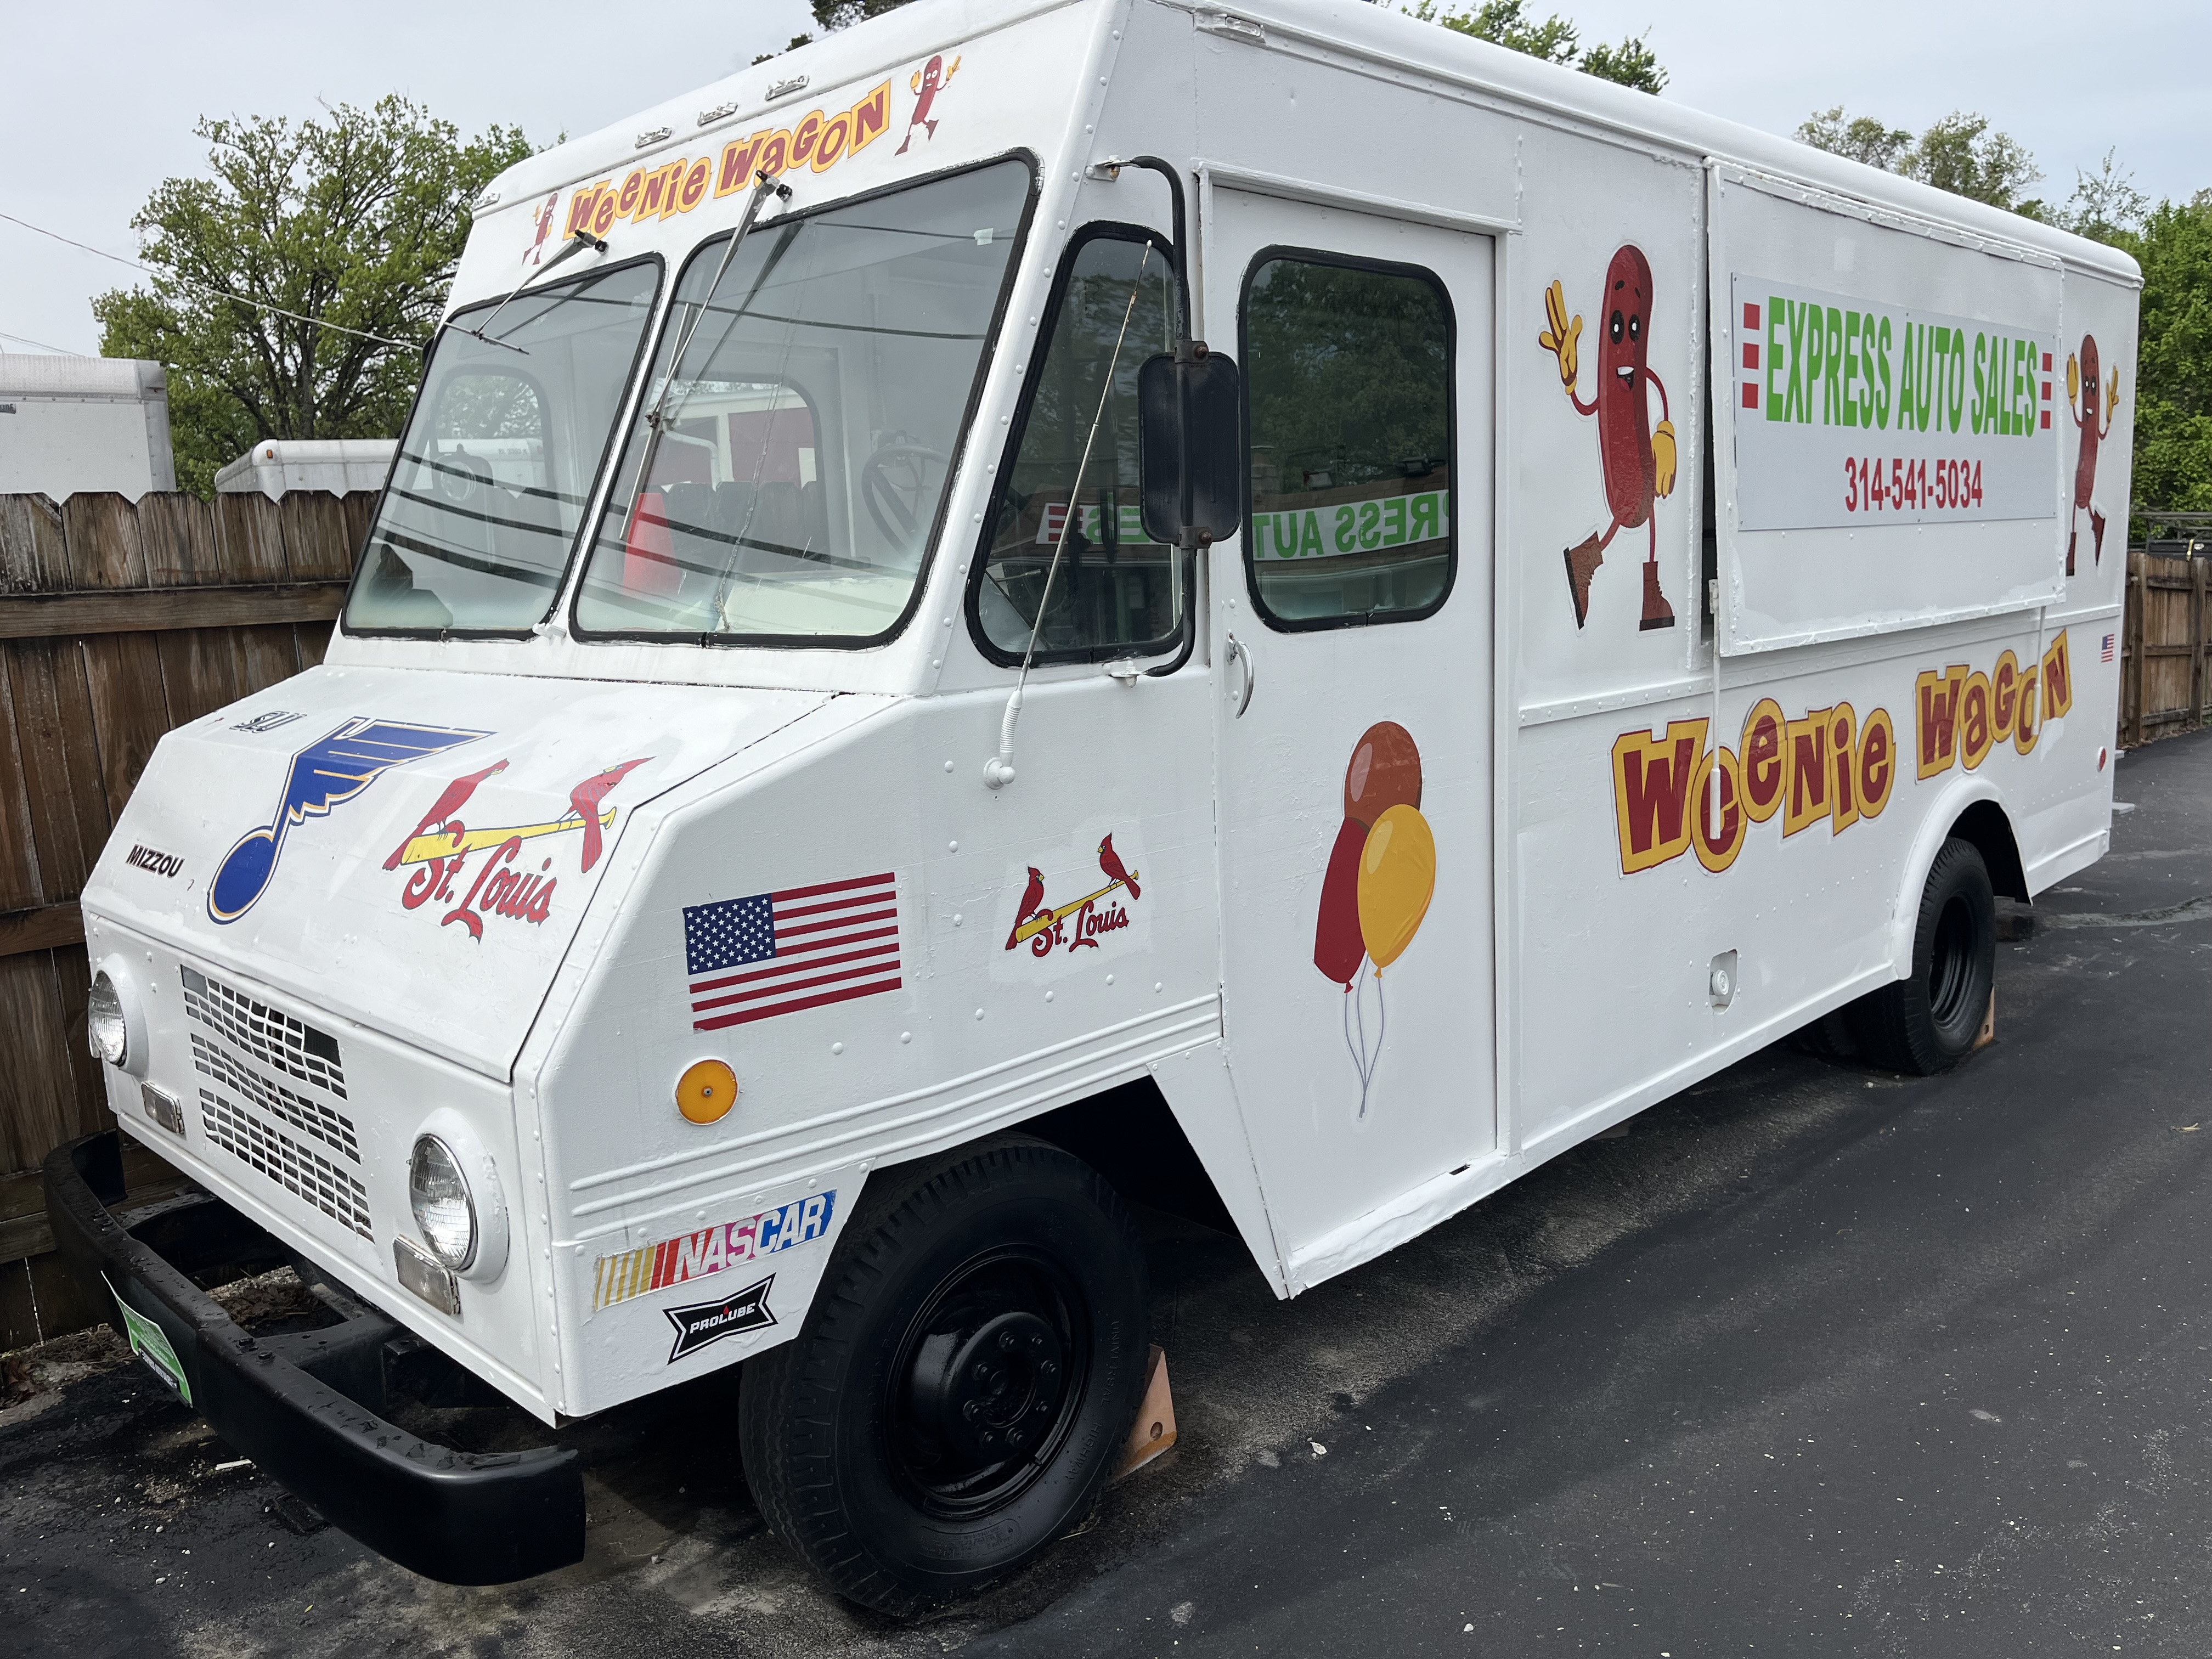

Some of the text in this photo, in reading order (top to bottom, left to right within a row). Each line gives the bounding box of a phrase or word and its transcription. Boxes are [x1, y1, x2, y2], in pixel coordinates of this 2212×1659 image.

[1766, 296, 2037, 438] EXPRESS AUTO SALES
[1844, 456, 1983, 512] 314-541-5034
[125, 843, 185, 878] MIZZOU
[441, 835, 557, 945] Louis
[1068, 900, 1130, 953] Louis
[673, 1194, 830, 1283] NASCAR
[689, 1302, 757, 1334] PROLUBE
[1065, 1421, 1103, 1481] HIGHWAY
